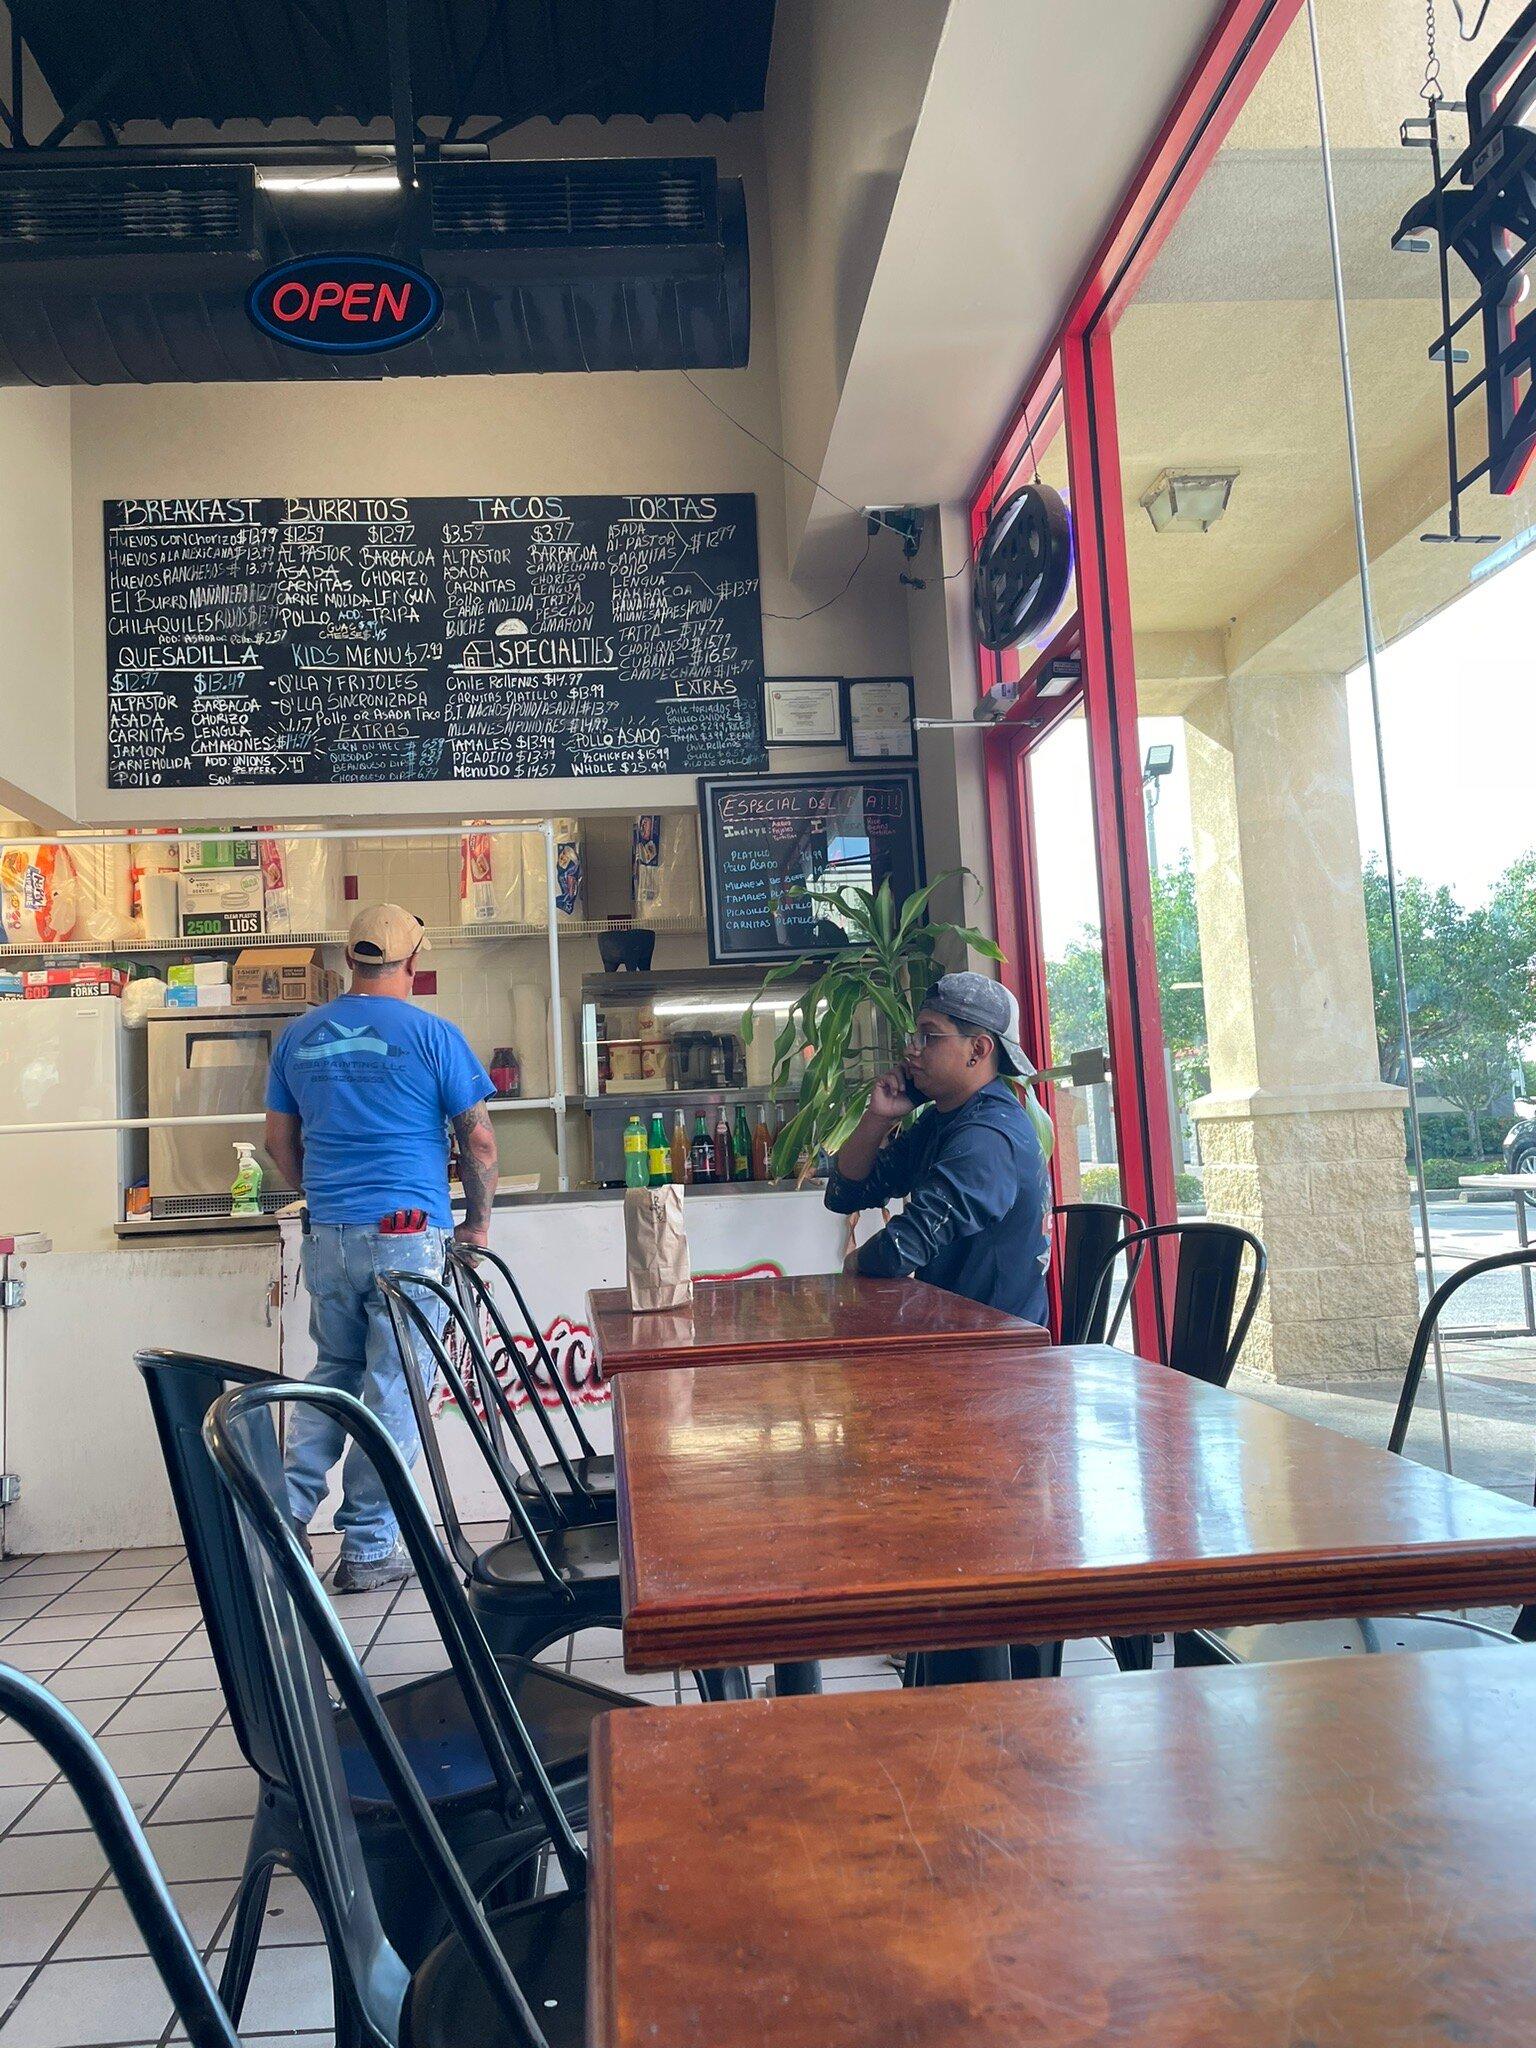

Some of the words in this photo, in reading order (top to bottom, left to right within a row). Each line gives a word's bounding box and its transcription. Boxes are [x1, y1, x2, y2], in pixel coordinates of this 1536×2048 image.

[273, 282, 412, 322] OPEN
[117, 500, 261, 526] BREAKFAST
[281, 498, 408, 521] BURRITOS
[468, 497, 563, 520] TACOS
[623, 497, 717, 520] TORTAS
[284, 525, 324, 542] $12.59
[368, 525, 415, 544] $12.97
[441, 523, 485, 544] $3.59
[531, 522, 574, 543] $3.97
[608, 523, 646, 540] ASADA
[625, 531, 676, 548] PASTOR
[279, 546, 295, 562] AL
[299, 545, 353, 566] PASTOR
[359, 548, 435, 570] BARBACOA
[443, 549, 459, 564] AL
[460, 549, 511, 565] PASTOR
[527, 545, 597, 563] BARBACOA
[608, 548, 677, 565] CARNITAS
[277, 563, 339, 579] ASADA
[443, 566, 489, 580] ASADA
[526, 560, 605, 575] CAMPECHANO
[278, 579, 353, 592] CARNITAS
[361, 570, 428, 587] CHORIZO
[531, 574, 586, 586] CHORIZO
[613, 576, 666, 588] LENGUA
[446, 579, 516, 595] CARNITAS
[533, 582, 581, 595] LENGUA
[277, 593, 319, 605] CARNE
[326, 594, 372, 608] MOLIDA
[374, 588, 436, 606] LENGUA
[541, 593, 582, 608] TRIPA
[443, 604, 484, 618] CARNE
[488, 594, 533, 613] MOLIDA
[536, 602, 594, 620] PESCADO
[109, 612, 213, 635] CHILAQUILES
[280, 609, 330, 628] POLLO
[338, 610, 363, 621] ADD:
[367, 608, 419, 623] TRIPA
[327, 622, 356, 632] GUAC
[446, 618, 485, 639] BUCHE
[530, 615, 592, 635] CAMARON
[619, 624, 661, 642] TRIPA
[119, 645, 259, 667] QUESADILLA
[292, 644, 340, 667] KIDS
[346, 644, 400, 667] MENU
[499, 637, 614, 665] SPECIALTIES
[620, 653, 675, 668] CUBANA
[618, 665, 712, 681] CAMPECHANA
[322, 675, 331, 693] Y
[337, 674, 418, 692] FRIJOLES
[675, 679, 737, 697] EXTRAS
[110, 699, 128, 713] AL
[127, 696, 178, 711] PASTOR
[191, 699, 262, 713] BARBACOA
[328, 691, 427, 710] SINCRONIZADA
[449, 692, 501, 704] CARNITAS
[111, 713, 164, 729] ASADA
[191, 714, 248, 726] CHORIZO
[412, 707, 440, 721] TACO
[109, 727, 185, 743] CARNITAS
[195, 725, 252, 739] LENGUA
[339, 723, 410, 739] EXTRAS
[576, 733, 613, 747] POLLO
[618, 727, 660, 745] ASADO
[113, 745, 165, 758] JAMON
[191, 737, 272, 754] CAMARONES
[445, 738, 511, 752] TAMALES
[110, 759, 150, 771] CARNE
[152, 758, 192, 770] MOLIDA
[205, 756, 231, 767] ADD:
[233, 756, 271, 766] ONIONS
[593, 752, 634, 762] CHICKEN
[571, 763, 616, 776] WHOLE
[619, 761, 667, 775] $25.99
[723, 798, 800, 817] ESPECIAL
[809, 796, 837, 810] DEL
[726, 893, 767, 903] TAMALES
[726, 906, 770, 917] PICADILLO
[187, 920, 221, 934] 2500
[229, 918, 258, 932] LIDS
[726, 921, 771, 930] CARNITAS
[71, 985, 99, 997] FORKS
